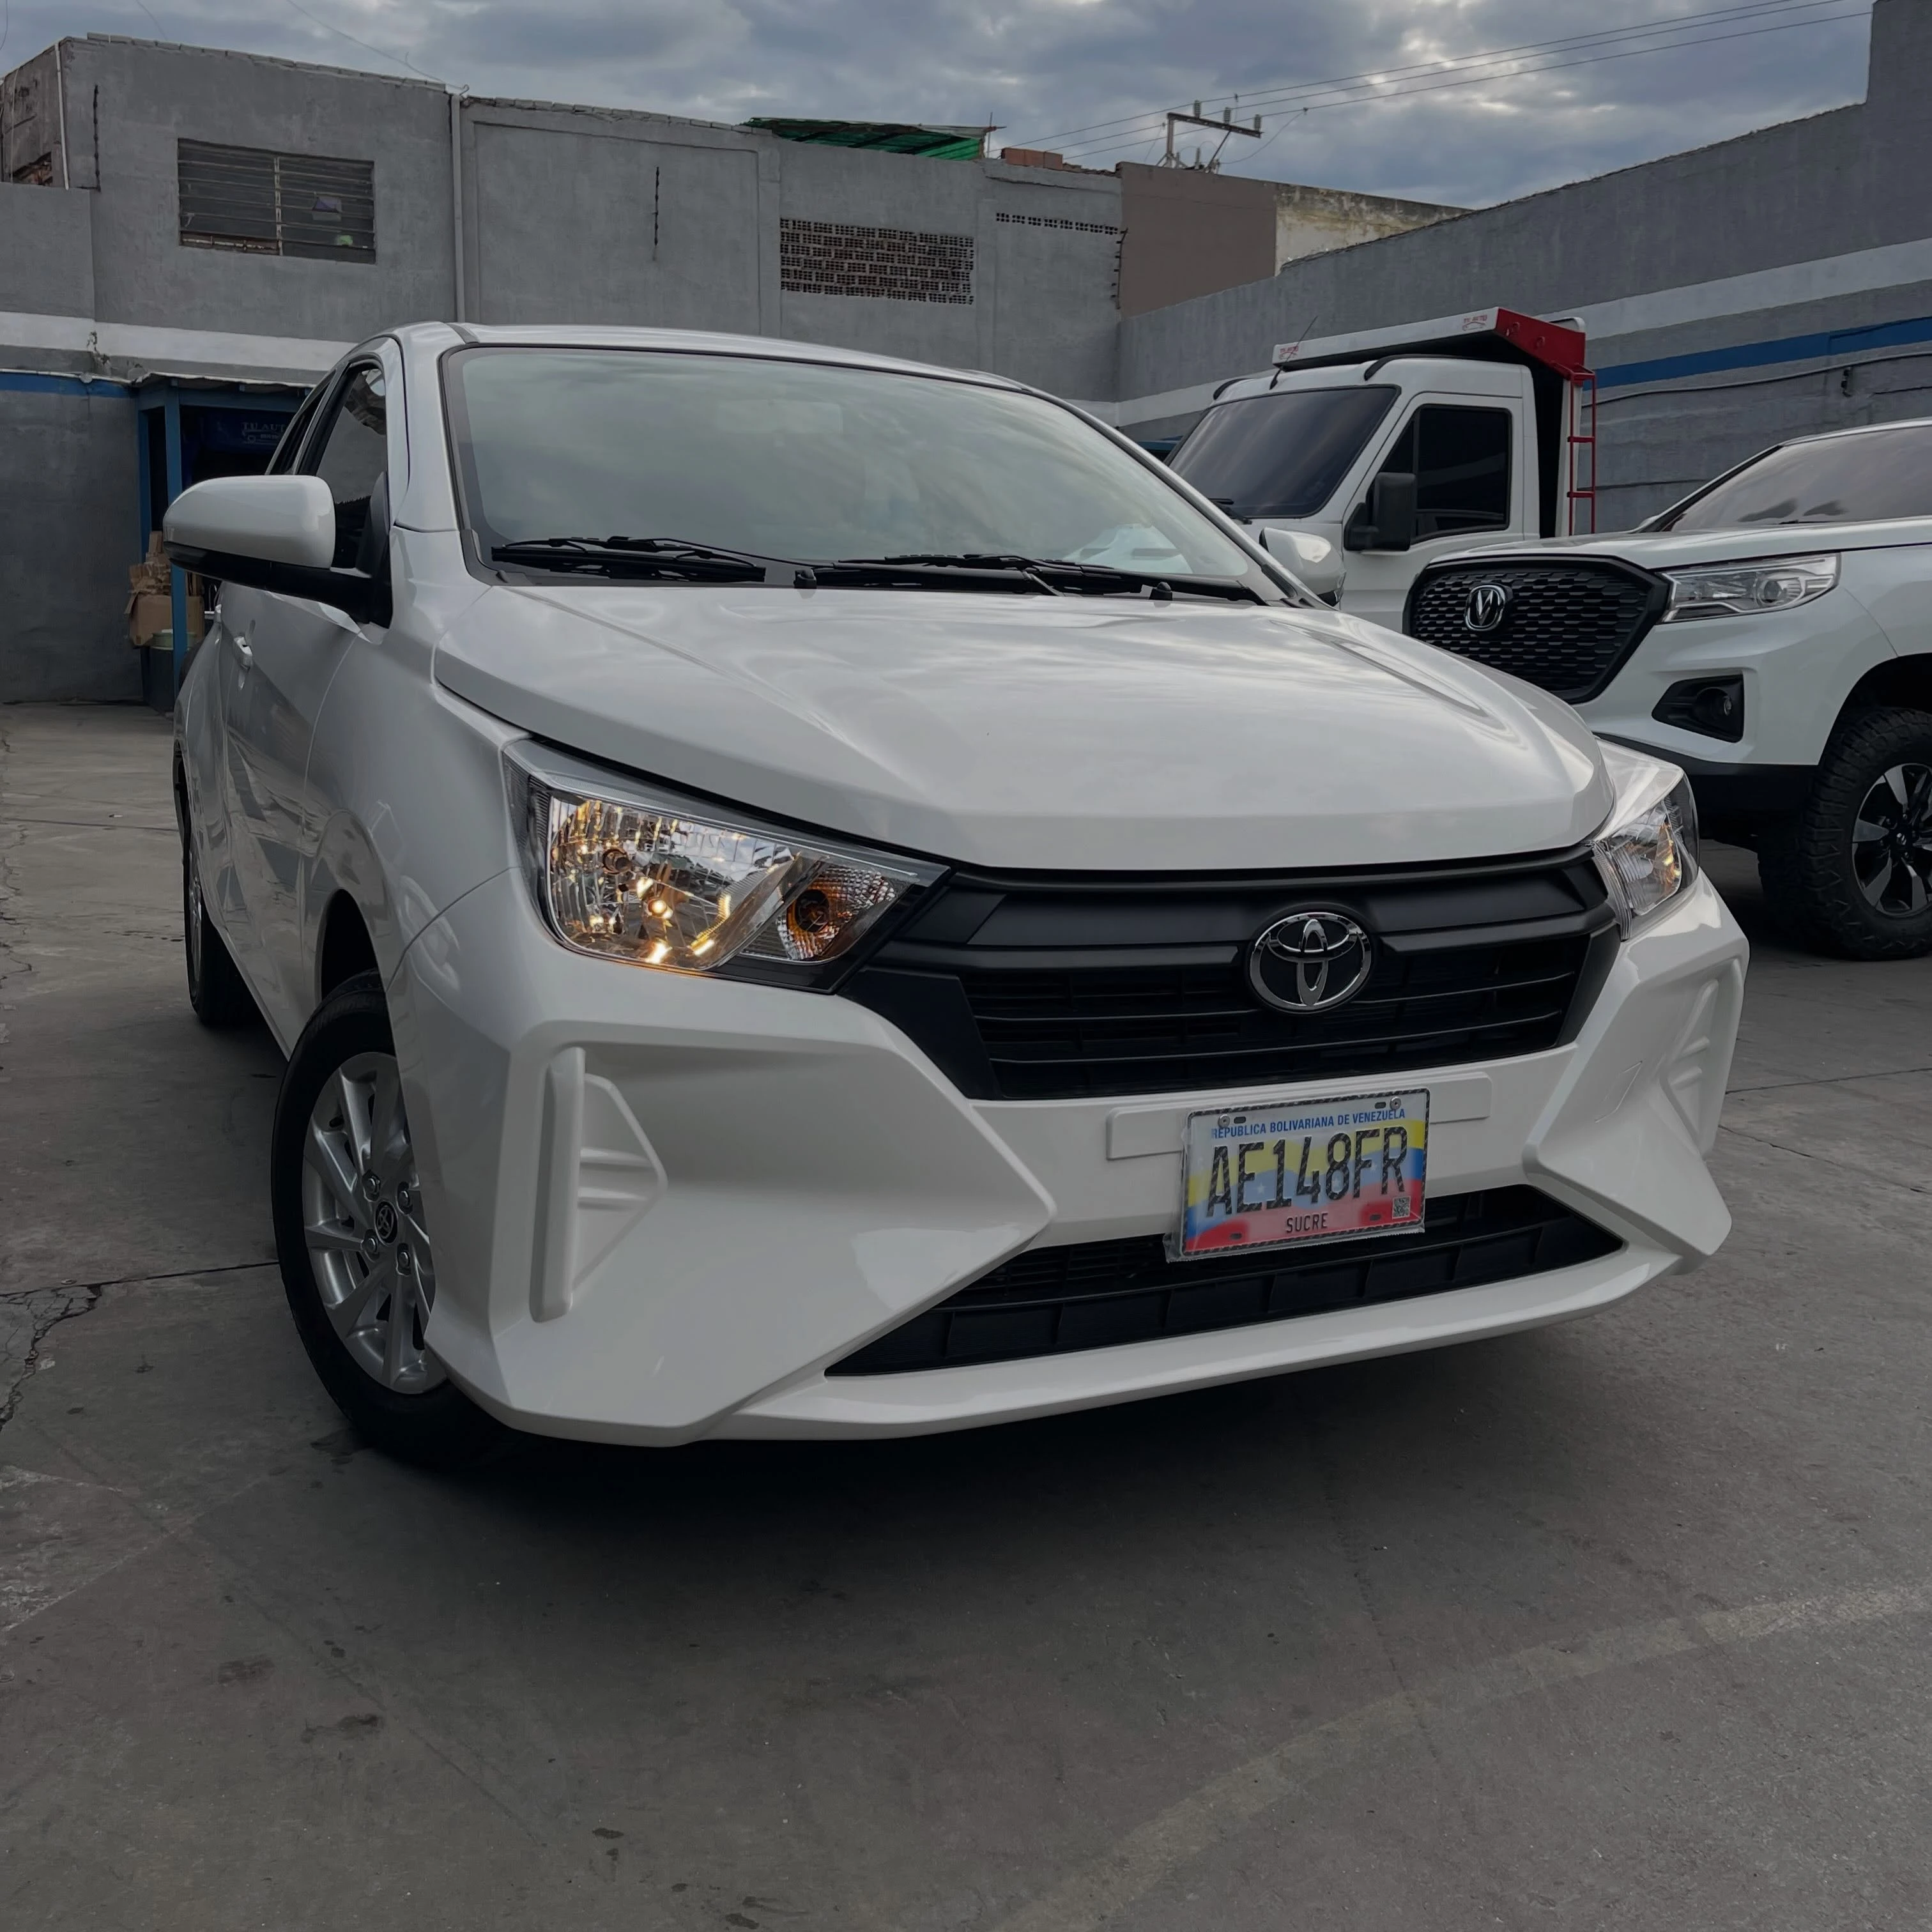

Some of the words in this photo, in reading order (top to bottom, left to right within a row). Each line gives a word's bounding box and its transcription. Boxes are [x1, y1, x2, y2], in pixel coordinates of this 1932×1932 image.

[241, 422, 258, 430] TU
[261, 424, 287, 432] AUT
[1270, 1116, 1334, 1132] BOLIVARIANA
[1337, 1114, 1350, 1125] DE
[1353, 1108, 1405, 1123] VENEZUELA
[1207, 1126, 1407, 1217] AE148FR
[1286, 1213, 1328, 1233] SUCRE
